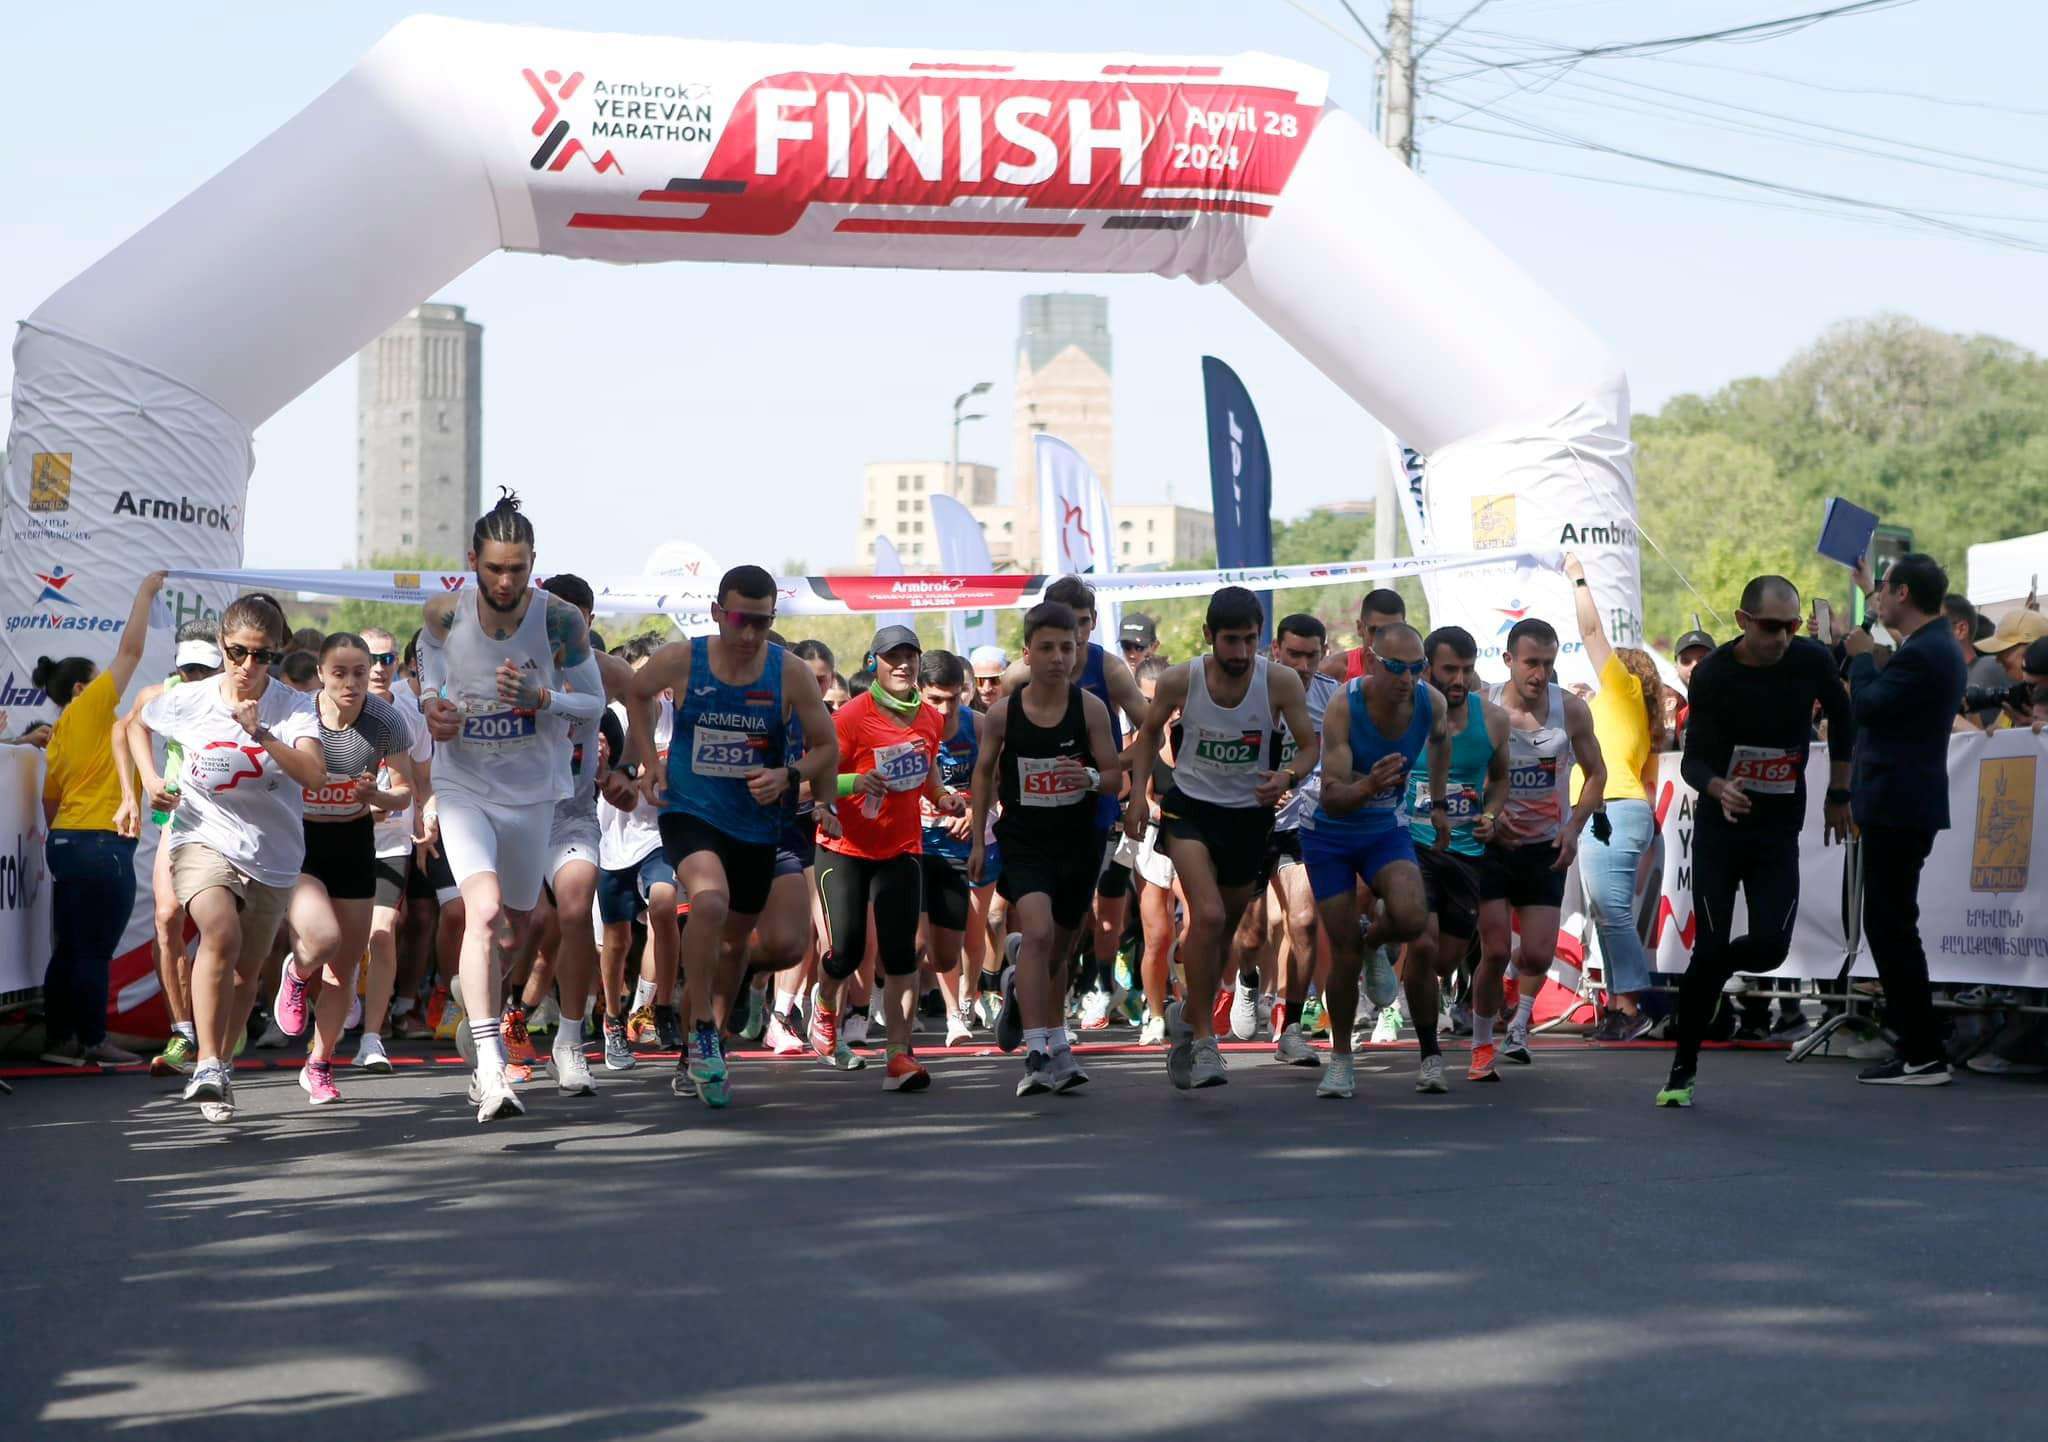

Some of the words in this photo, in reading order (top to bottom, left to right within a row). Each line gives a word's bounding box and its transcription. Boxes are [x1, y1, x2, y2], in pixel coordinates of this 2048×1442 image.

[593, 80, 689, 100] Armbrok
[594, 99, 712, 123] YEREVAN
[591, 121, 712, 143] MARATHON
[1184, 105, 1258, 141] April
[1263, 111, 1298, 138] 28
[754, 88, 1143, 187] FINISH
[1173, 143, 1240, 171] 2024
[112, 490, 231, 532] Armbrok
[892, 580, 951, 593] Armbrok
[468, 718, 524, 737] 2001
[697, 711, 768, 730] ARMENIA
[703, 745, 754, 764] 2391
[1201, 742, 1251, 761] 1002
[884, 756, 924, 777] 2135
[1738, 760, 1792, 780] 5169
[1509, 771, 1548, 787] 002
[304, 786, 357, 803] 5005
[1446, 799, 1471, 815] 38
